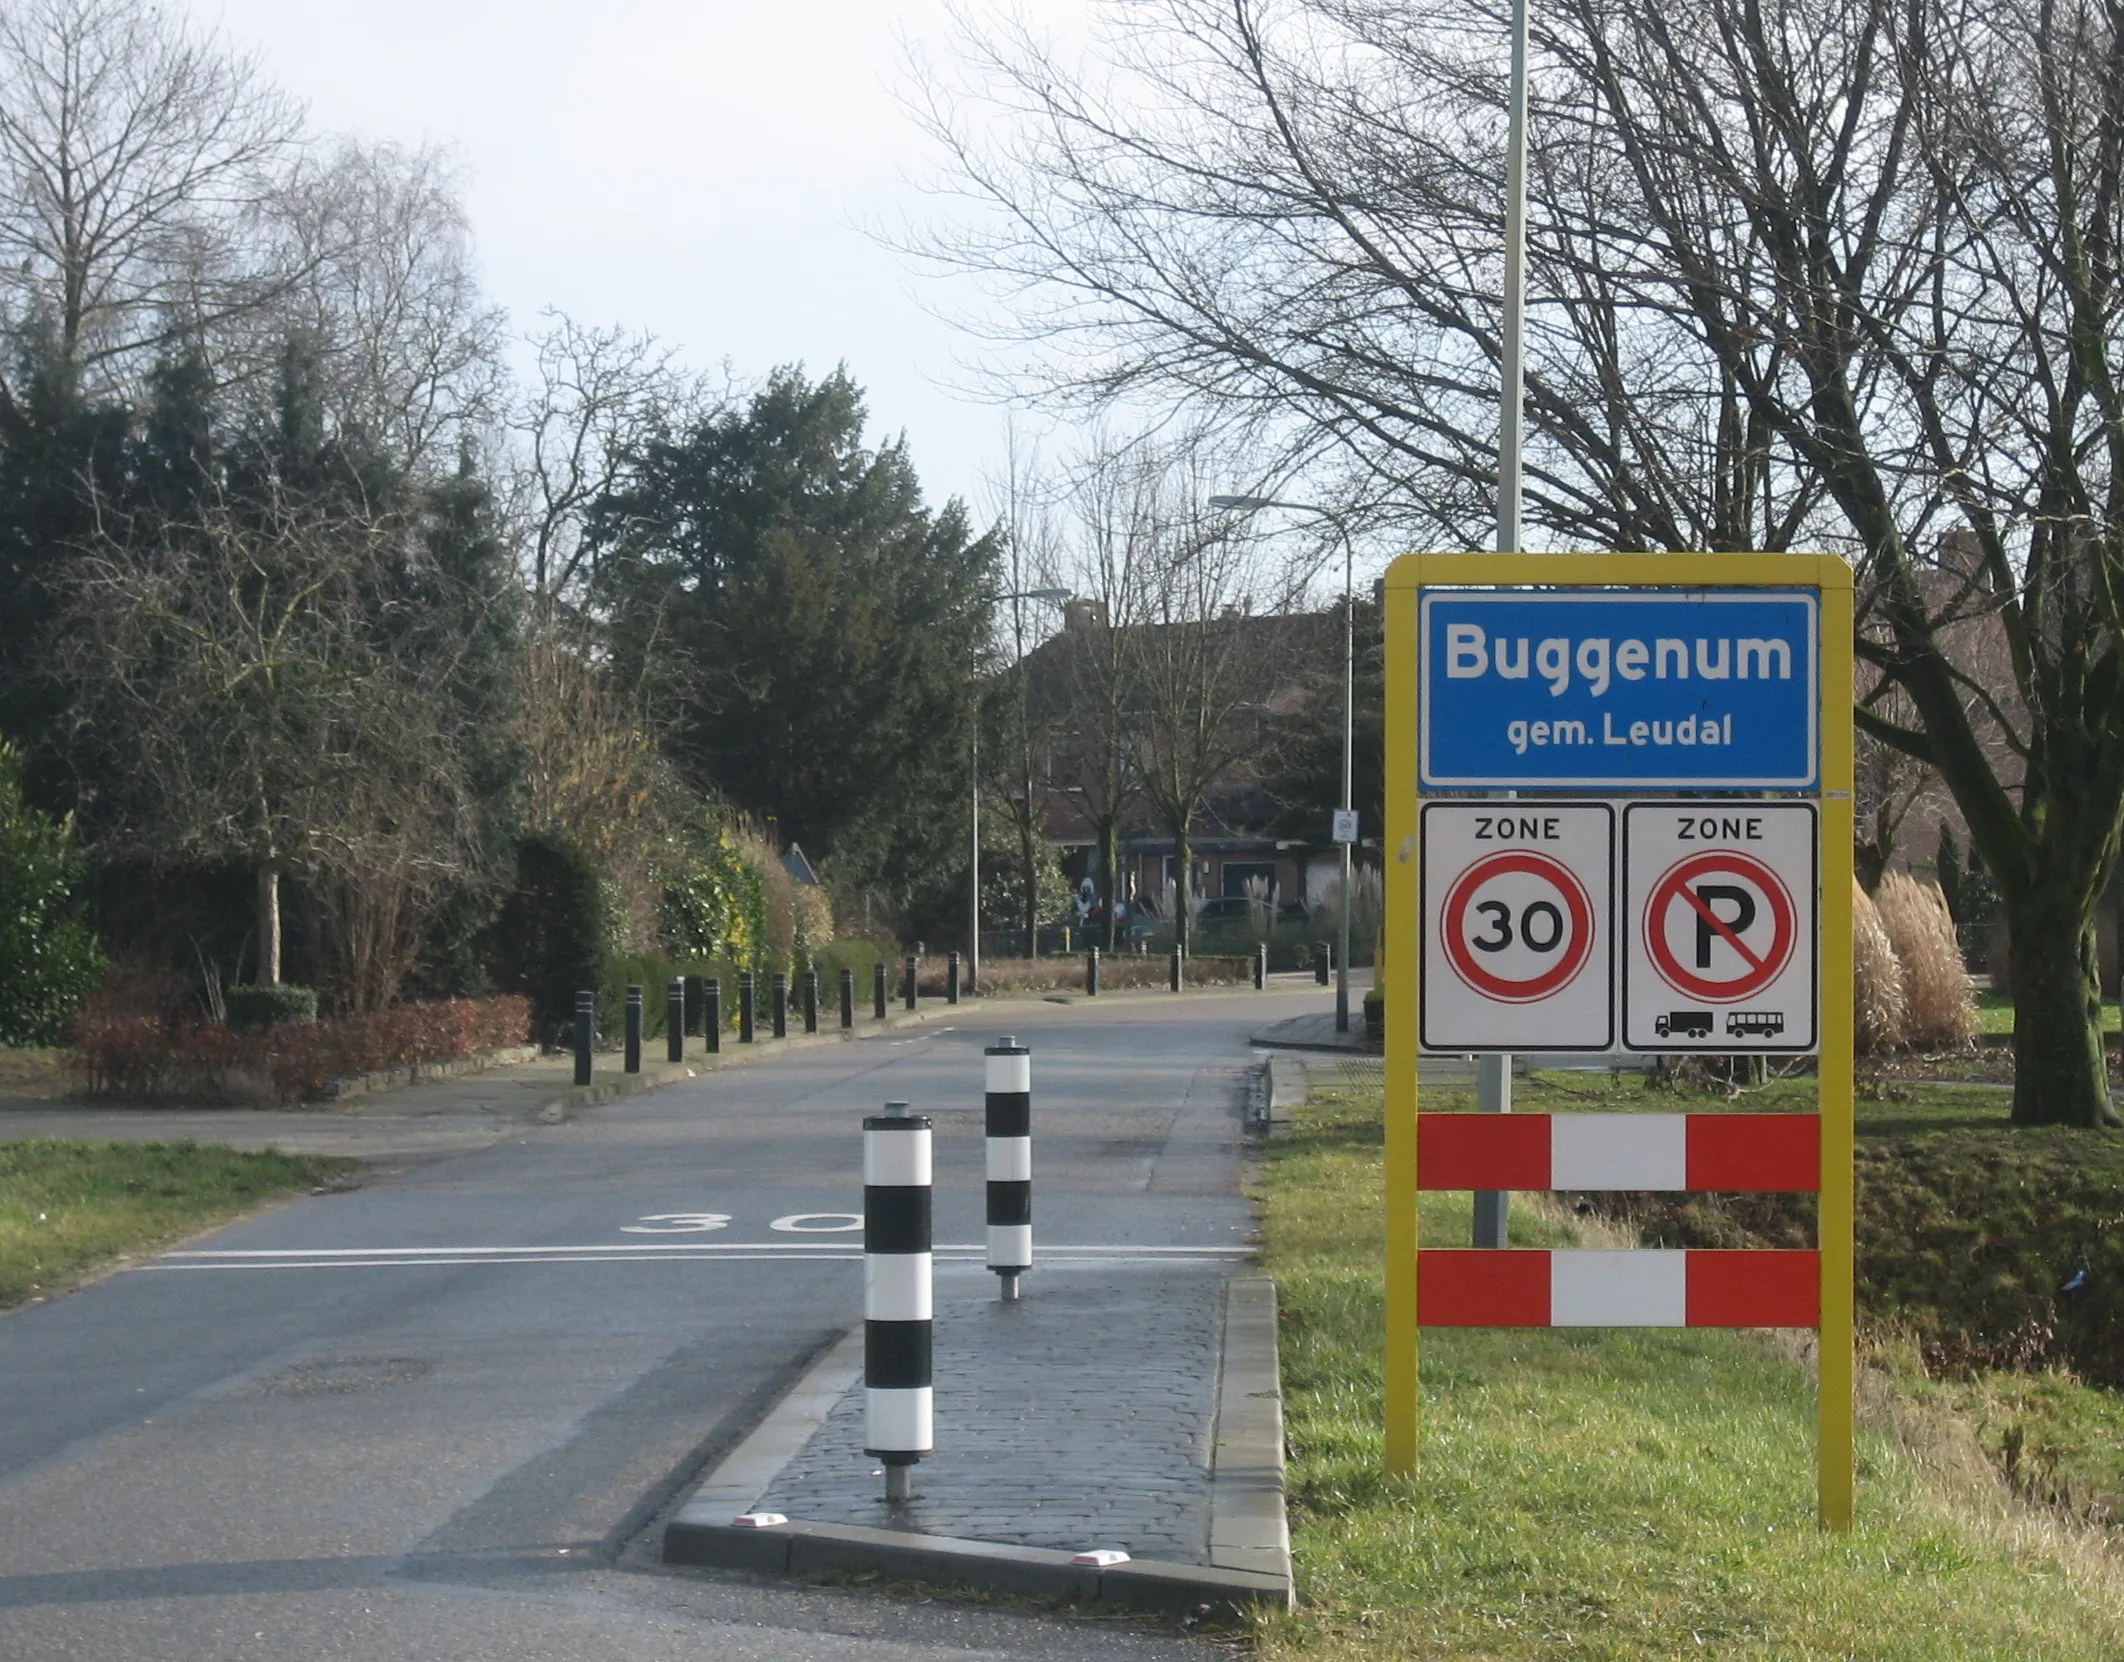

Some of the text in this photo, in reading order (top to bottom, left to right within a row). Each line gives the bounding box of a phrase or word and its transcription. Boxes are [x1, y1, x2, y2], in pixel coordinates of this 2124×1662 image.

[1446, 623, 1791, 697] Buggenum
[1507, 712, 1731, 755] gem. Leudal
[1475, 817, 1561, 840] ZONE
[1677, 817, 1763, 840] ZONE
[1471, 900, 1564, 953] 30
[1696, 885, 1756, 968] P
